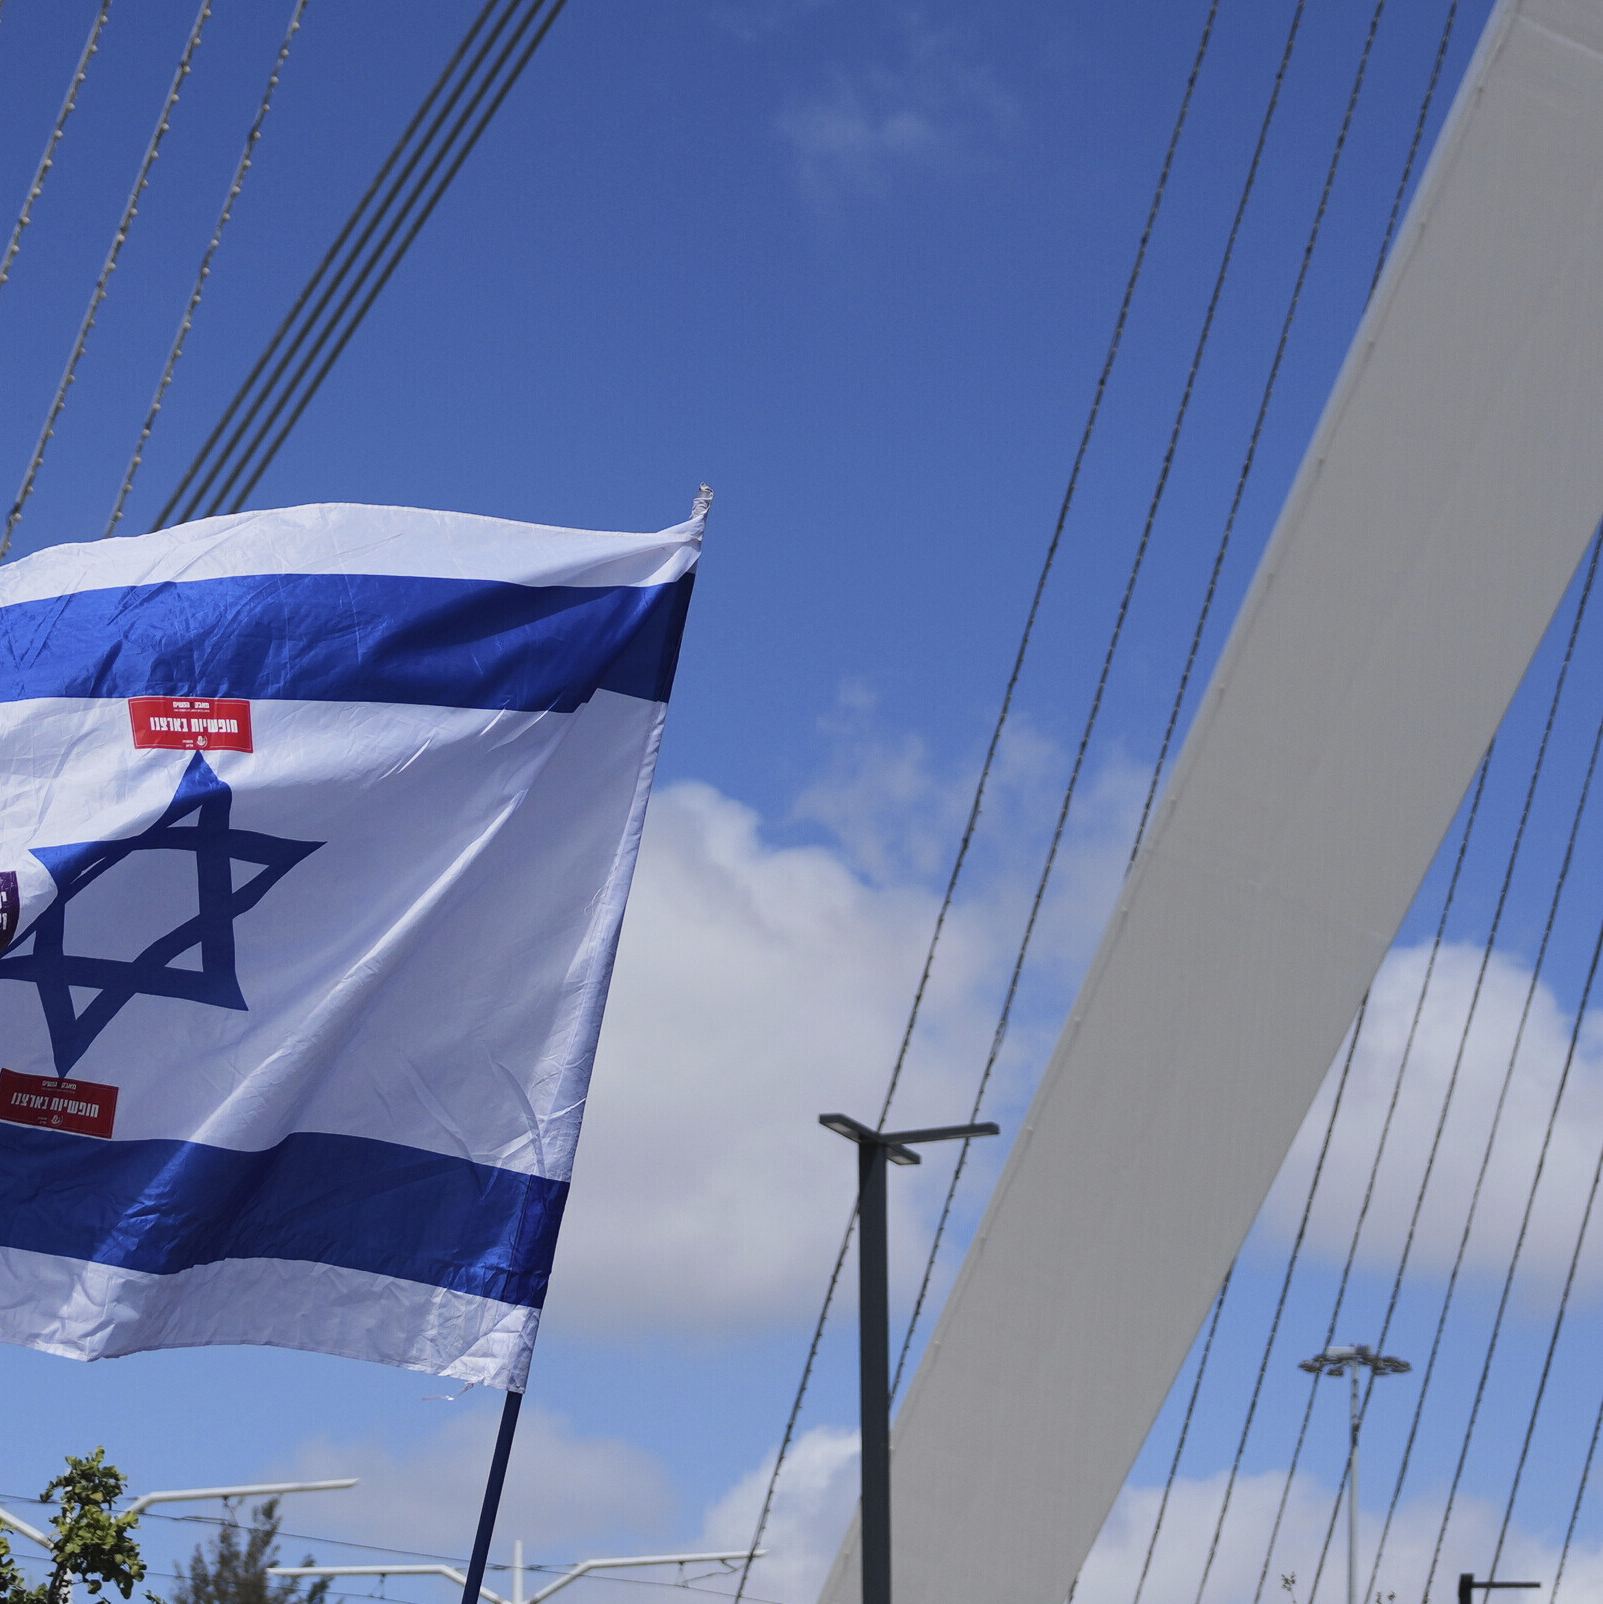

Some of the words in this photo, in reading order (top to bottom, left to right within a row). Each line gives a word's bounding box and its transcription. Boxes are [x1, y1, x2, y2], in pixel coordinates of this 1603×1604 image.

[149, 716, 189, 732] בארצנו
[191, 718, 239, 733] חופשיות
[10, 1091, 49, 1110] בארצנו
[50, 1097, 100, 1118] חופשיות
